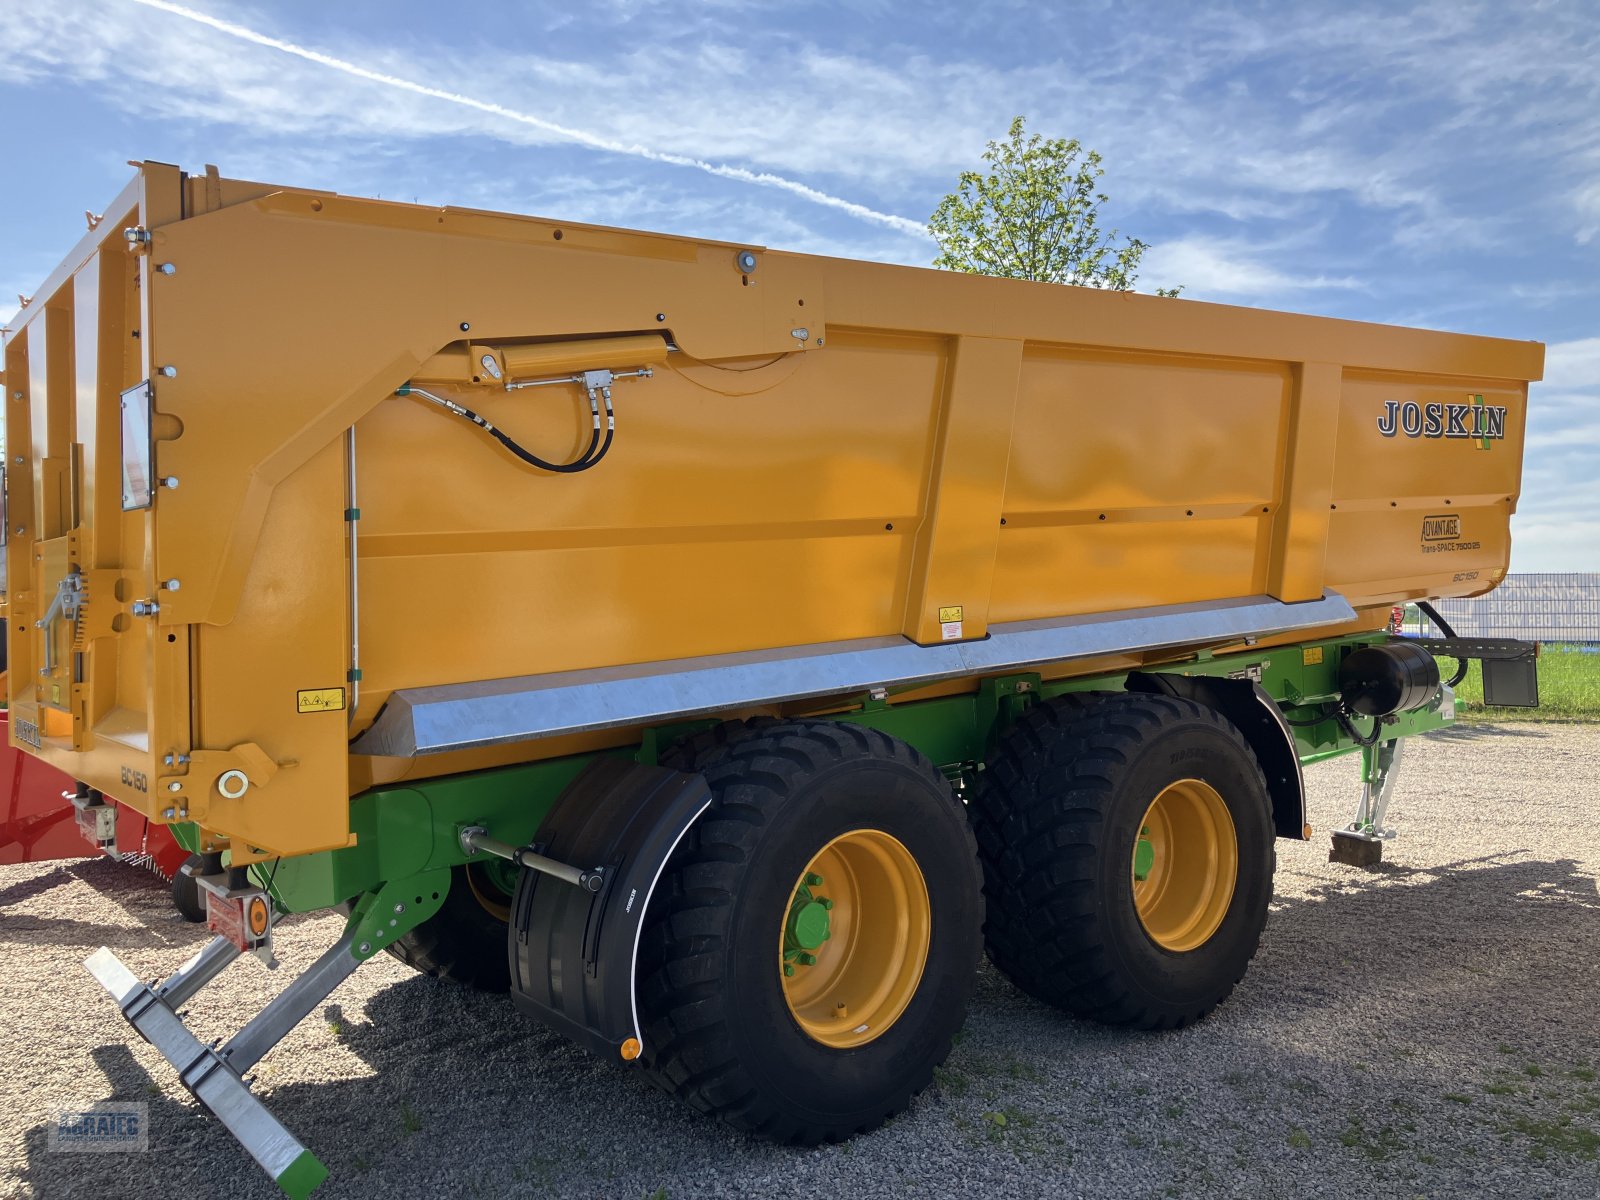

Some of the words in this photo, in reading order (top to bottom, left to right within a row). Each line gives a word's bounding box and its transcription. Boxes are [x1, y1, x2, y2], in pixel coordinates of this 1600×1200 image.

[1376, 399, 1507, 440] JOSKIN
[1421, 517, 1459, 541] ADVANTAGE
[626, 888, 637, 913] JOSKIN
